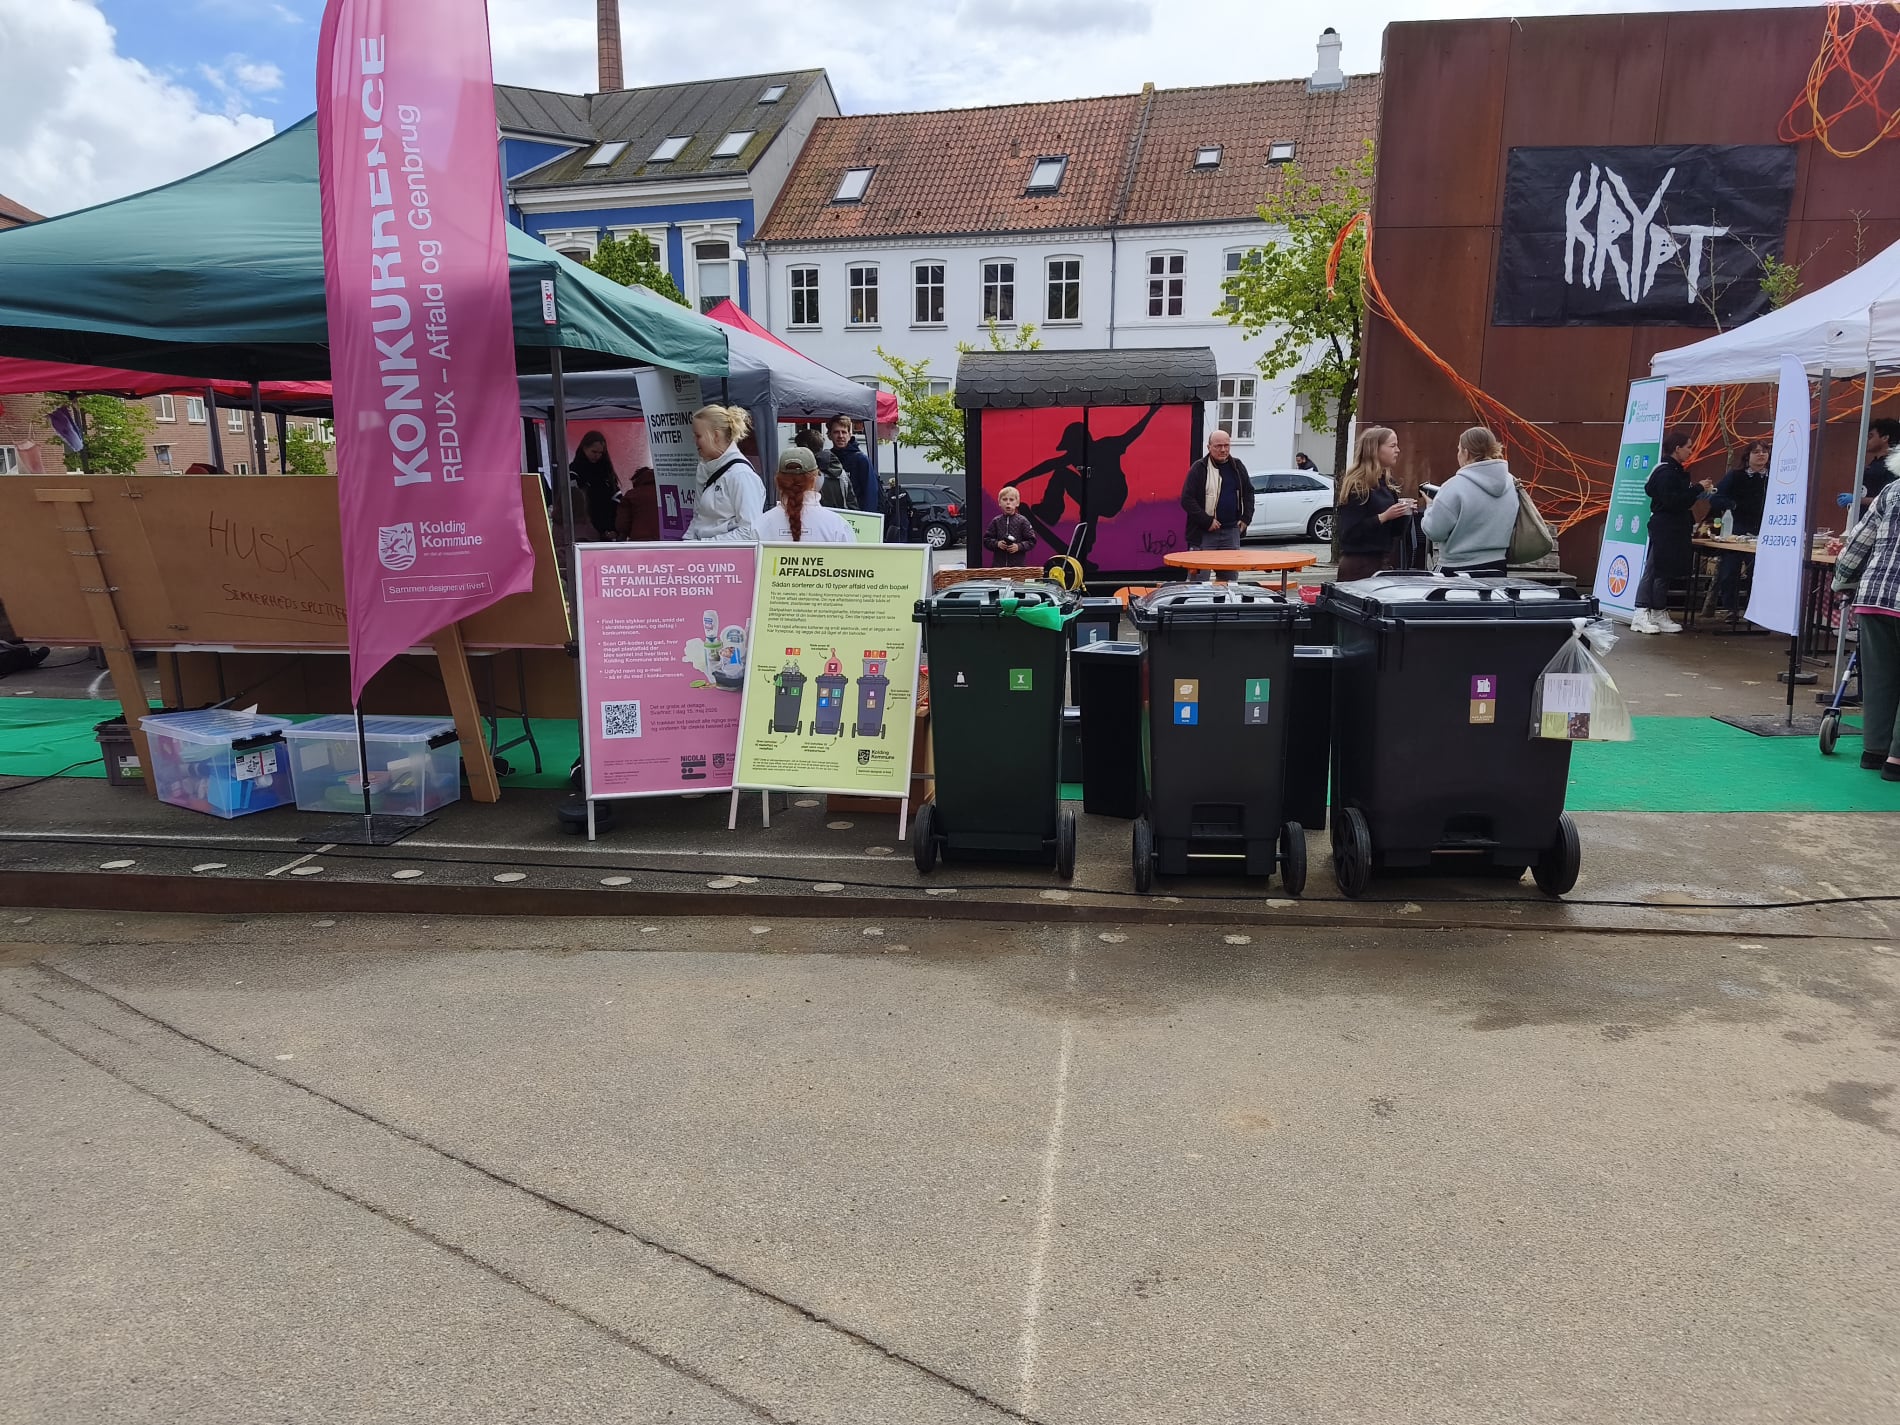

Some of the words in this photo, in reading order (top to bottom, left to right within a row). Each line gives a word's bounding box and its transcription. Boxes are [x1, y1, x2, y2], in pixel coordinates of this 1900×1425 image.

[398, 104, 432, 230] Genbrug
[1564, 162, 1731, 304] KRYPT
[360, 34, 432, 487] KONKURRENCE
[419, 240, 442, 274] og
[420, 283, 451, 360] Affald
[651, 411, 694, 428] SORTERING
[434, 390, 464, 482] REDUX
[654, 430, 683, 444] NYTTER
[420, 520, 466, 534] Kolding
[422, 535, 482, 548] Kommune
[208, 510, 331, 592] HUSK
[780, 556, 799, 566] DIN
[802, 557, 824, 566] NYE
[600, 564, 634, 574] SAML
[638, 564, 675, 574] PLAST
[688, 564, 704, 572] OG
[708, 563, 736, 572] VIND
[779, 568, 874, 578] AFFALDSLØSNING
[602, 576, 616, 586] ET
[620, 574, 722, 586] FAMILIEÅRSKORT
[724, 574, 742, 584] TIL
[388, 585, 426, 594] Sammen
[602, 588, 650, 598] NICOLAI
[654, 587, 677, 596] FOR
[680, 586, 714, 596] BØRN
